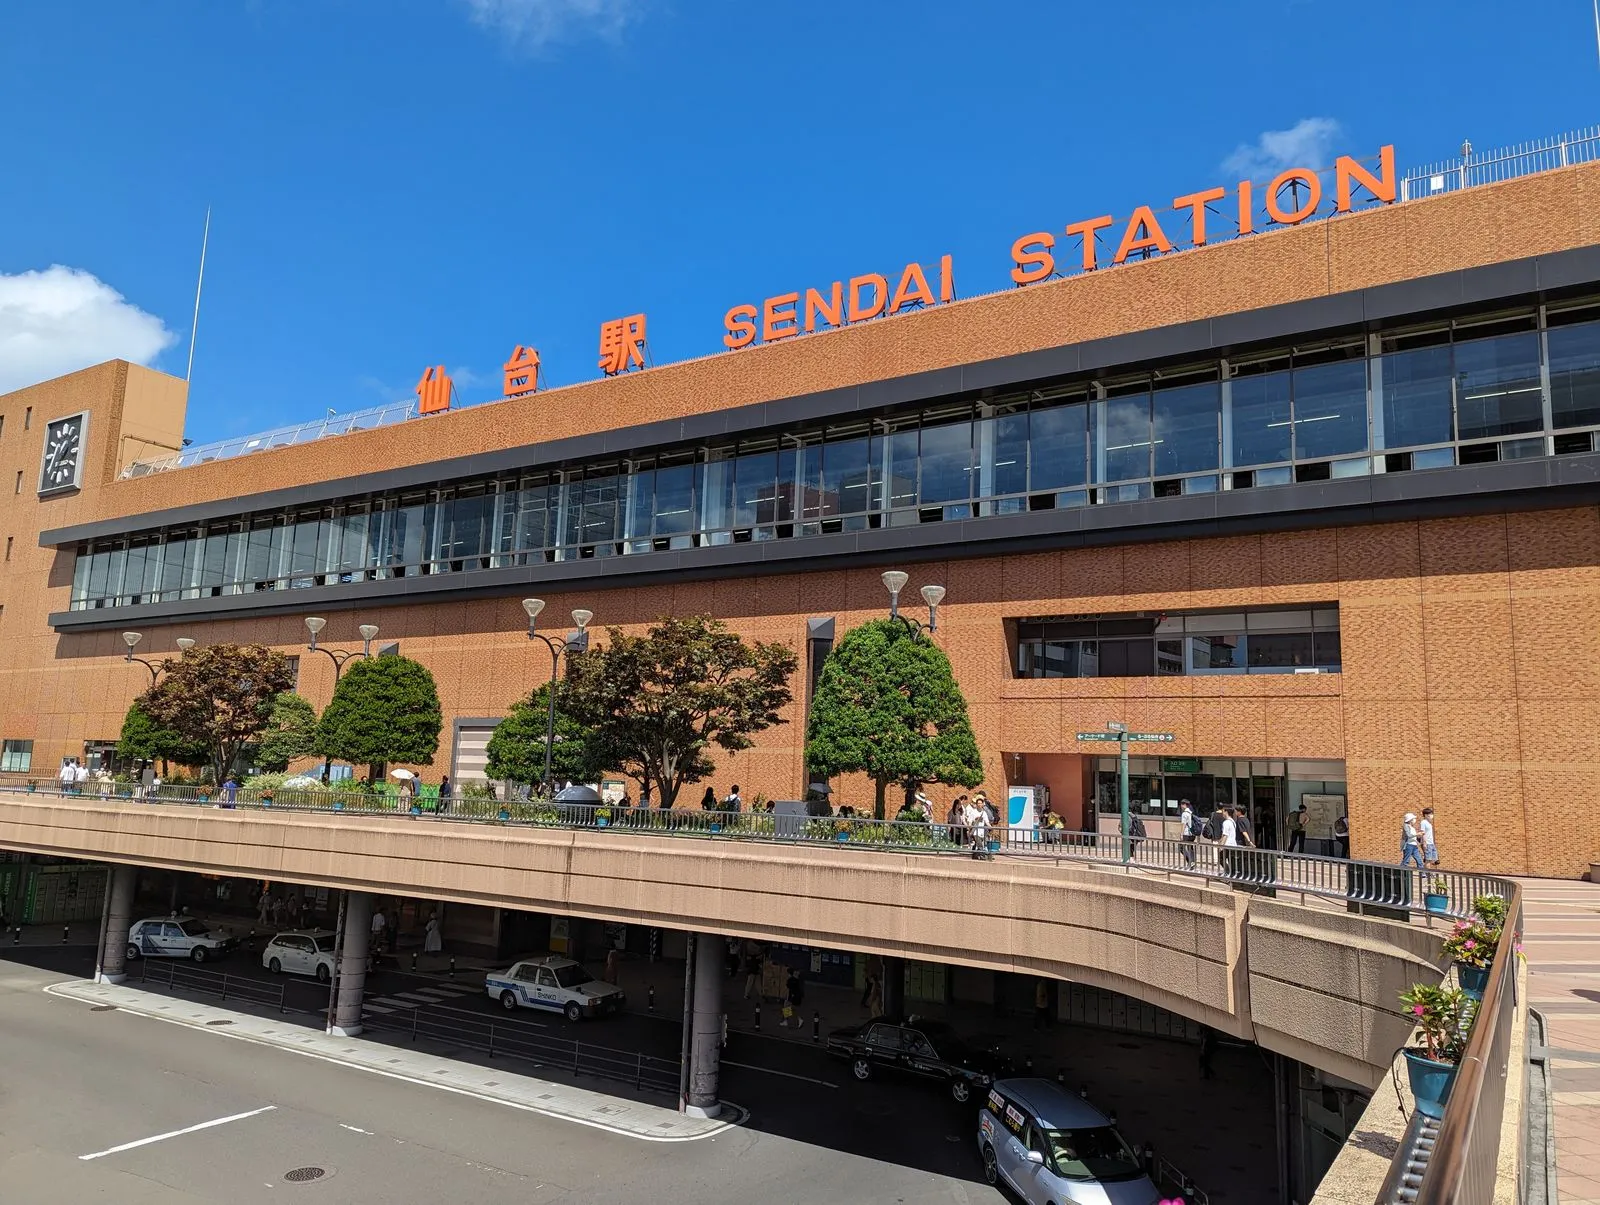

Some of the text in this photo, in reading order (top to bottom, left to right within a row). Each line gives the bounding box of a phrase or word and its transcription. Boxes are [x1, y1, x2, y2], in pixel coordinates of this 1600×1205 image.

[416, 144, 1396, 414] 仙台駅 SENDAI STATION
